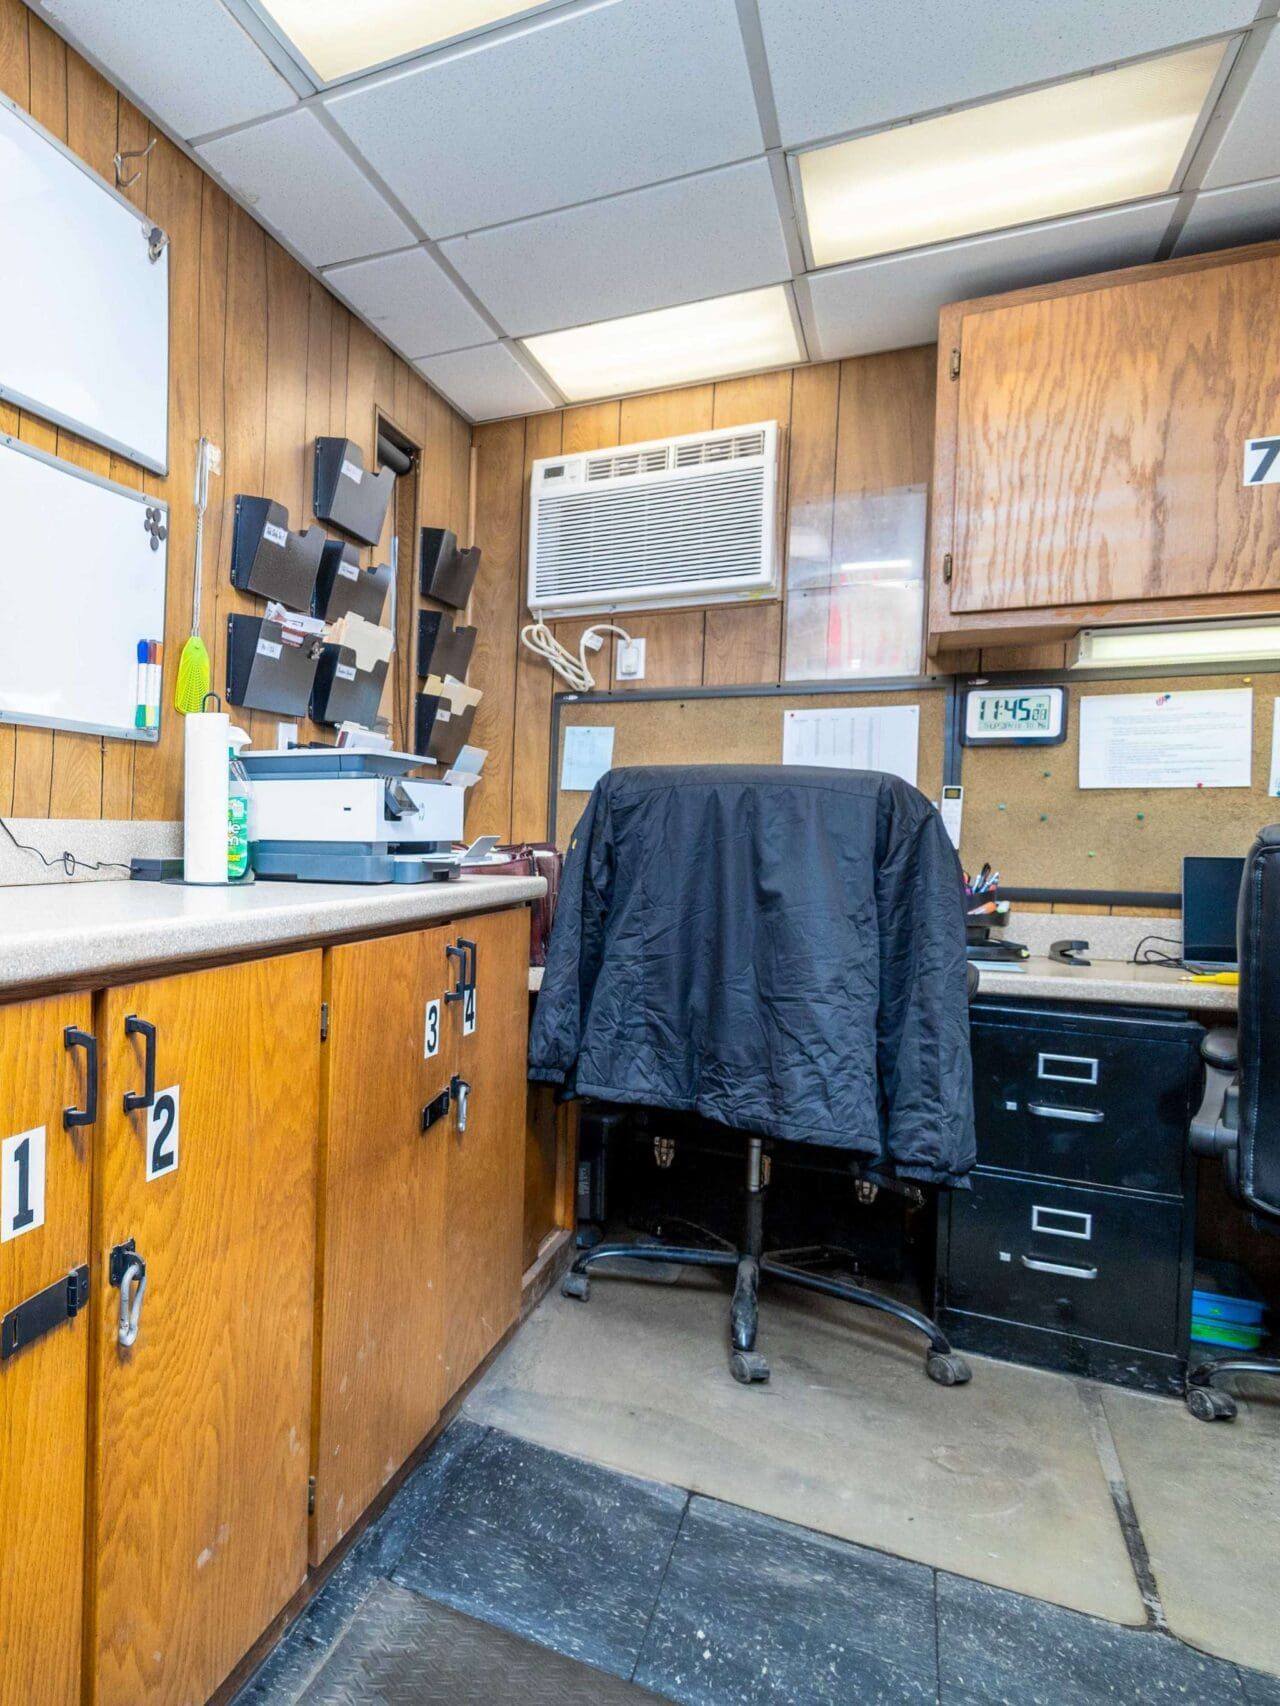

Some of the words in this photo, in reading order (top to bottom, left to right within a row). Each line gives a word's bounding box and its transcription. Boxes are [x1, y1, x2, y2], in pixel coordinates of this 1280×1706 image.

[1250, 438, 1280, 483] 7
[979, 698, 1031, 721] 11:45
[427, 1004, 438, 1054] 3
[464, 986, 475, 1031] 4
[152, 1094, 176, 1174] 2
[12, 1137, 35, 1232] 1
